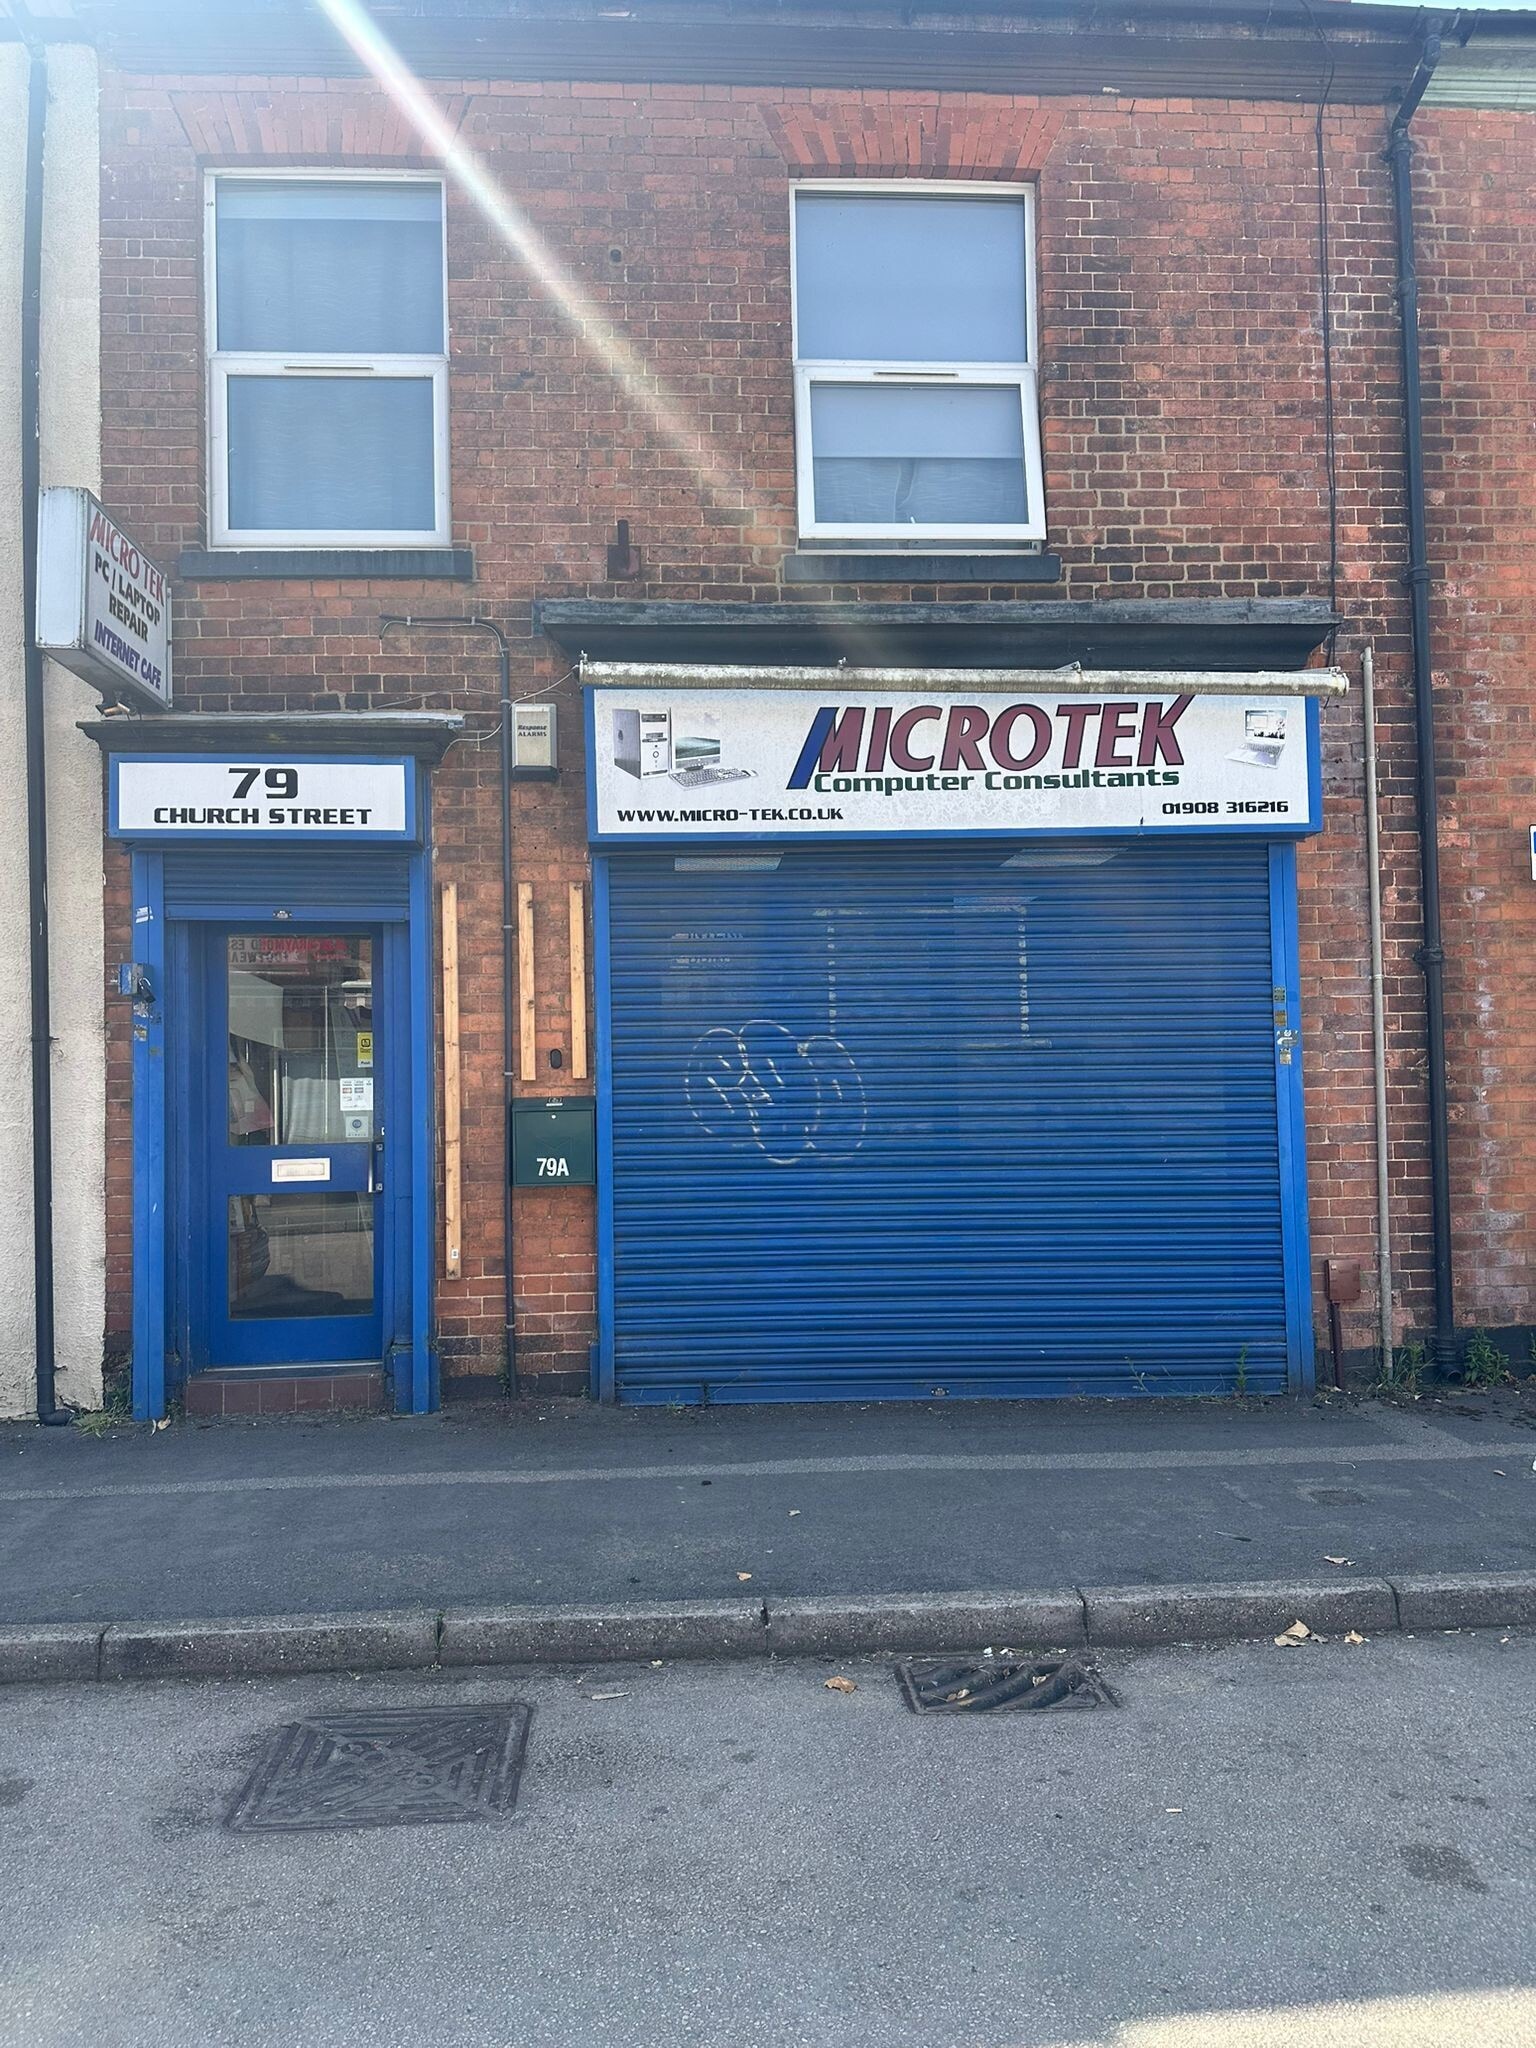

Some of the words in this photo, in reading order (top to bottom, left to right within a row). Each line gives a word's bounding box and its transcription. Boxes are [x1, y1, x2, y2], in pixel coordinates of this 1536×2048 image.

[89, 510, 140, 579] MICRO
[142, 559, 165, 607] TEK
[95, 552, 110, 583] PC
[118, 574, 161, 626] LAPTOP
[109, 592, 149, 642] REPAIR
[94, 619, 141, 671] INTERNET
[140, 656, 162, 691] CAFE
[786, 694, 1196, 790] MICROTEK
[227, 767, 299, 799] 79
[813, 774, 975, 796] Computer
[984, 769, 1180, 790] Consultants
[153, 807, 260, 824] CHURCH
[268, 808, 372, 824] STREET
[616, 807, 844, 823] WWW.MICRO-TEK.CO.UK
[1161, 802, 1220, 815] 01908
[1225, 801, 1289, 814] 316216
[536, 1157, 570, 1177] 79A
